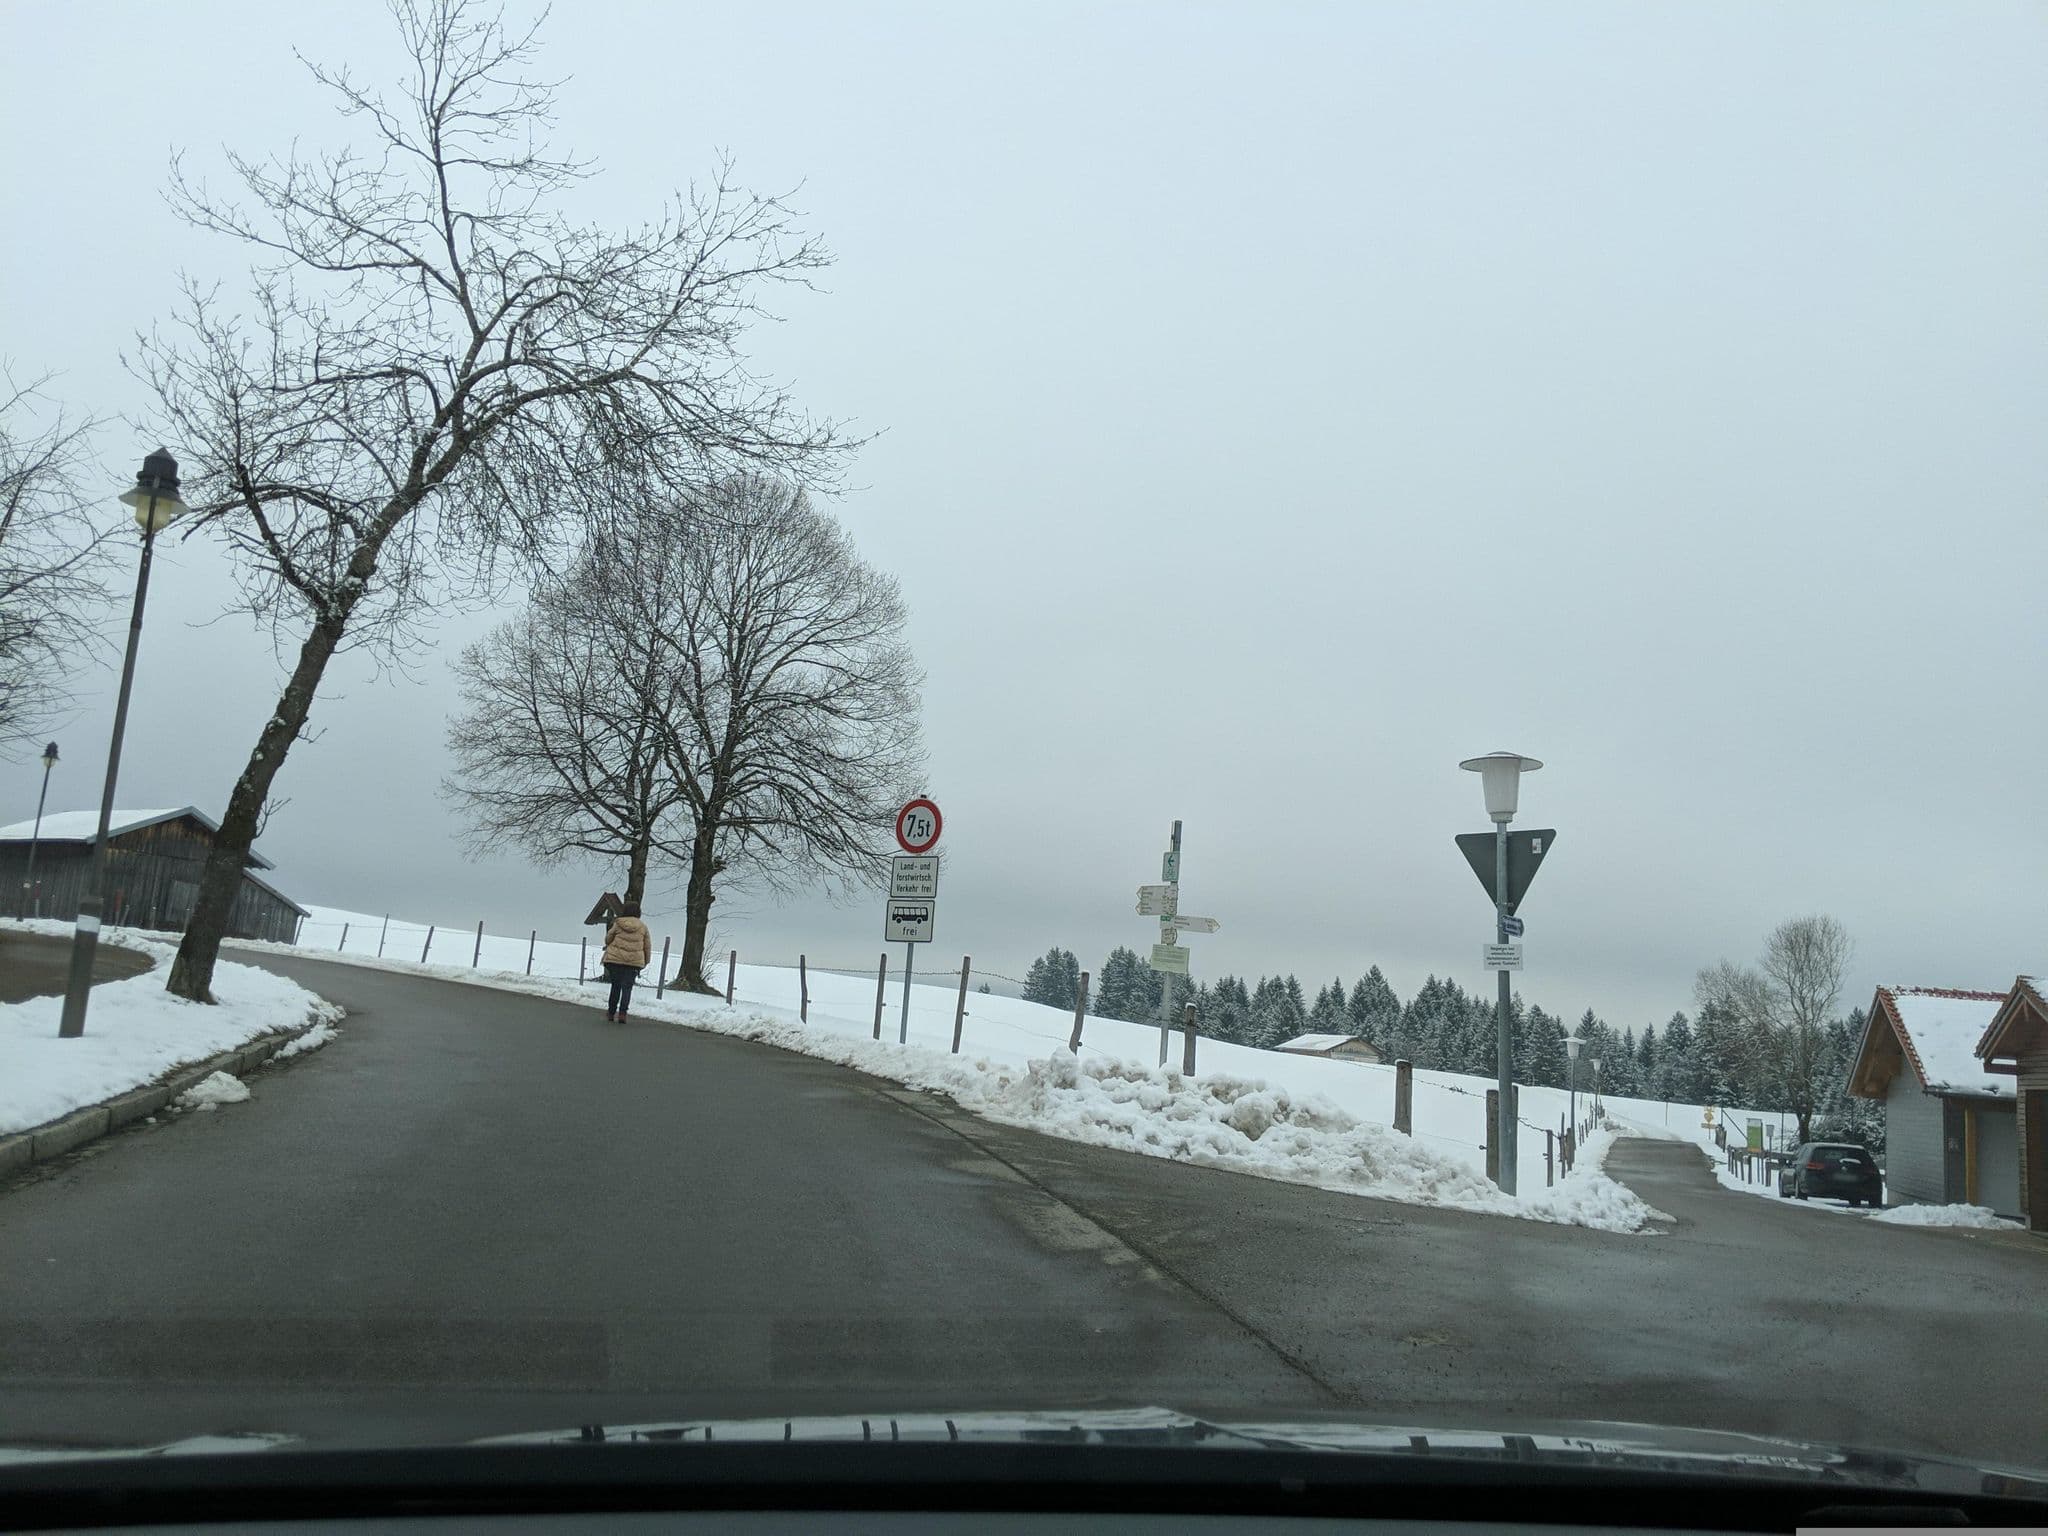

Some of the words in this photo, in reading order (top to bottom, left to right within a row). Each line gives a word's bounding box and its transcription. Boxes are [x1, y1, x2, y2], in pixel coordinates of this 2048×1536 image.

[919, 861, 931, 871] und
[896, 883, 919, 893] Verkehr
[921, 883, 932, 893] frei
[902, 926, 918, 936] frei
